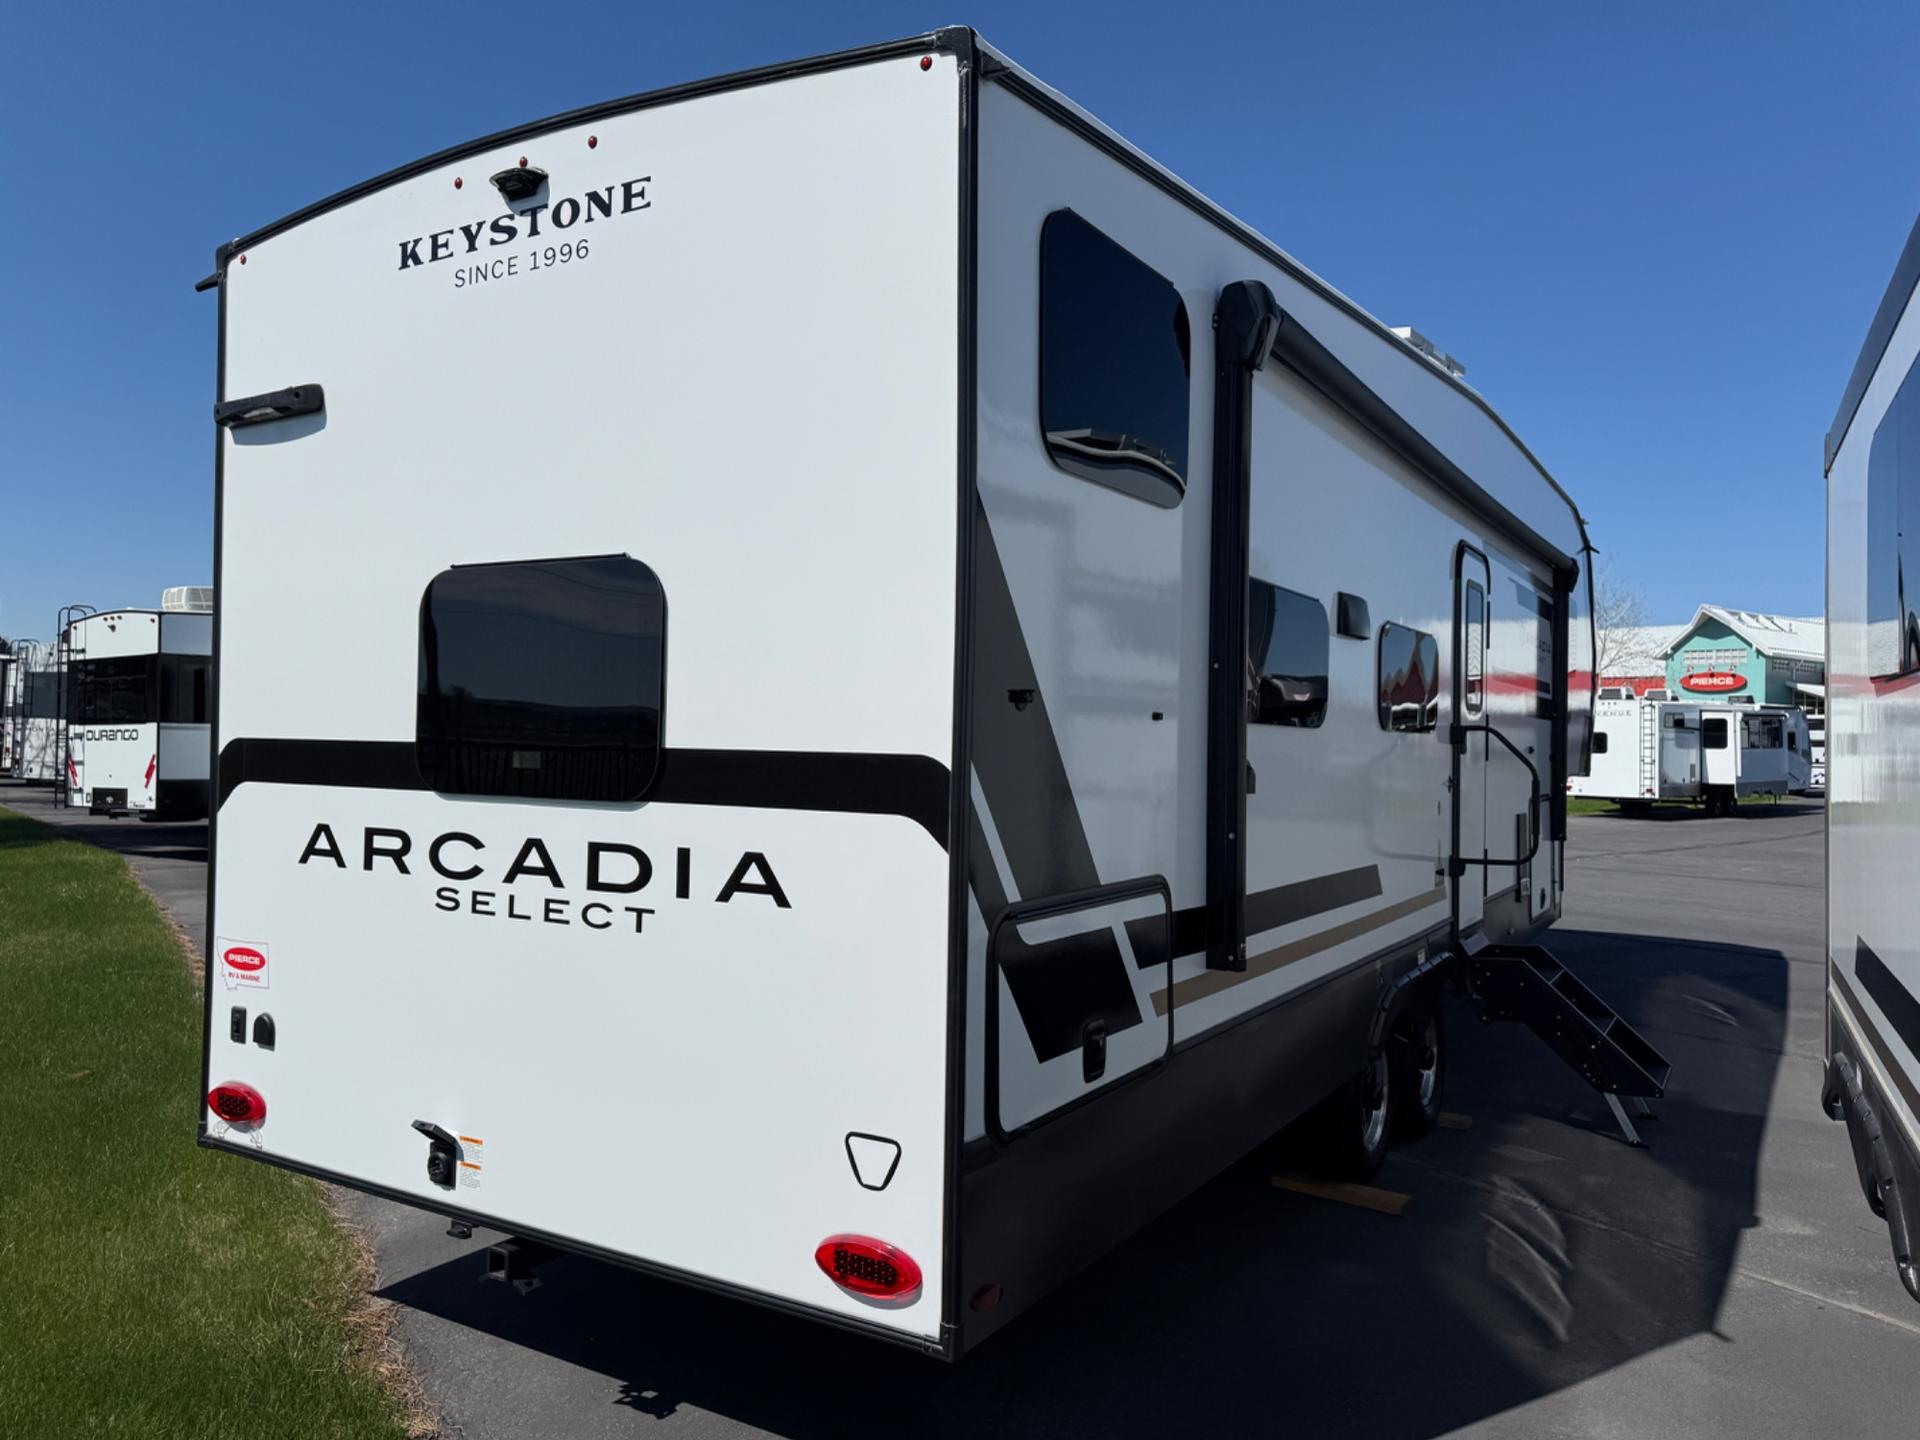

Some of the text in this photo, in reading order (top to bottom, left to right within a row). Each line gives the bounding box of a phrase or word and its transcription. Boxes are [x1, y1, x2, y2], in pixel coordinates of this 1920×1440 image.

[398, 176, 651, 271] KEYSTONE
[454, 239, 589, 288] SINCE 1996
[1690, 676, 1734, 685] PIERCE
[86, 729, 139, 741] DURANGO
[298, 823, 792, 909] ARCADIA
[435, 887, 655, 933] SELECT
[228, 953, 260, 966] PIERCE
